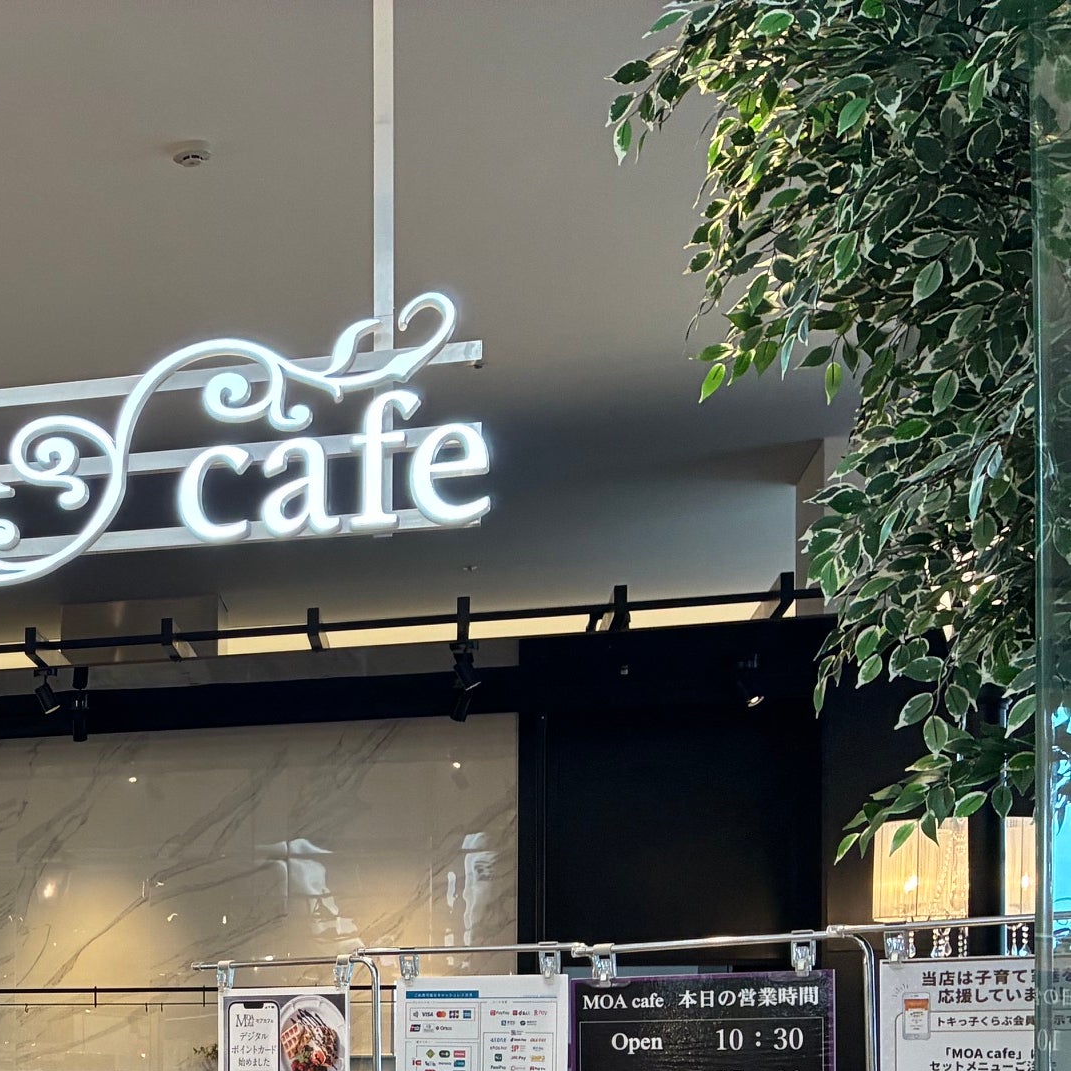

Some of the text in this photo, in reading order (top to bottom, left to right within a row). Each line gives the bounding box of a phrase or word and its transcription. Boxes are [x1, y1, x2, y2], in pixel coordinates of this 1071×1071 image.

[178, 389, 492, 547] cafe
[583, 986, 819, 1009] MOA cafe 本日の営業時間
[240, 1032, 268, 1041] デジタル
[611, 1033, 663, 1054] Open
[231, 1045, 276, 1054] ポイントカード
[239, 1057, 270, 1066] 始めました
